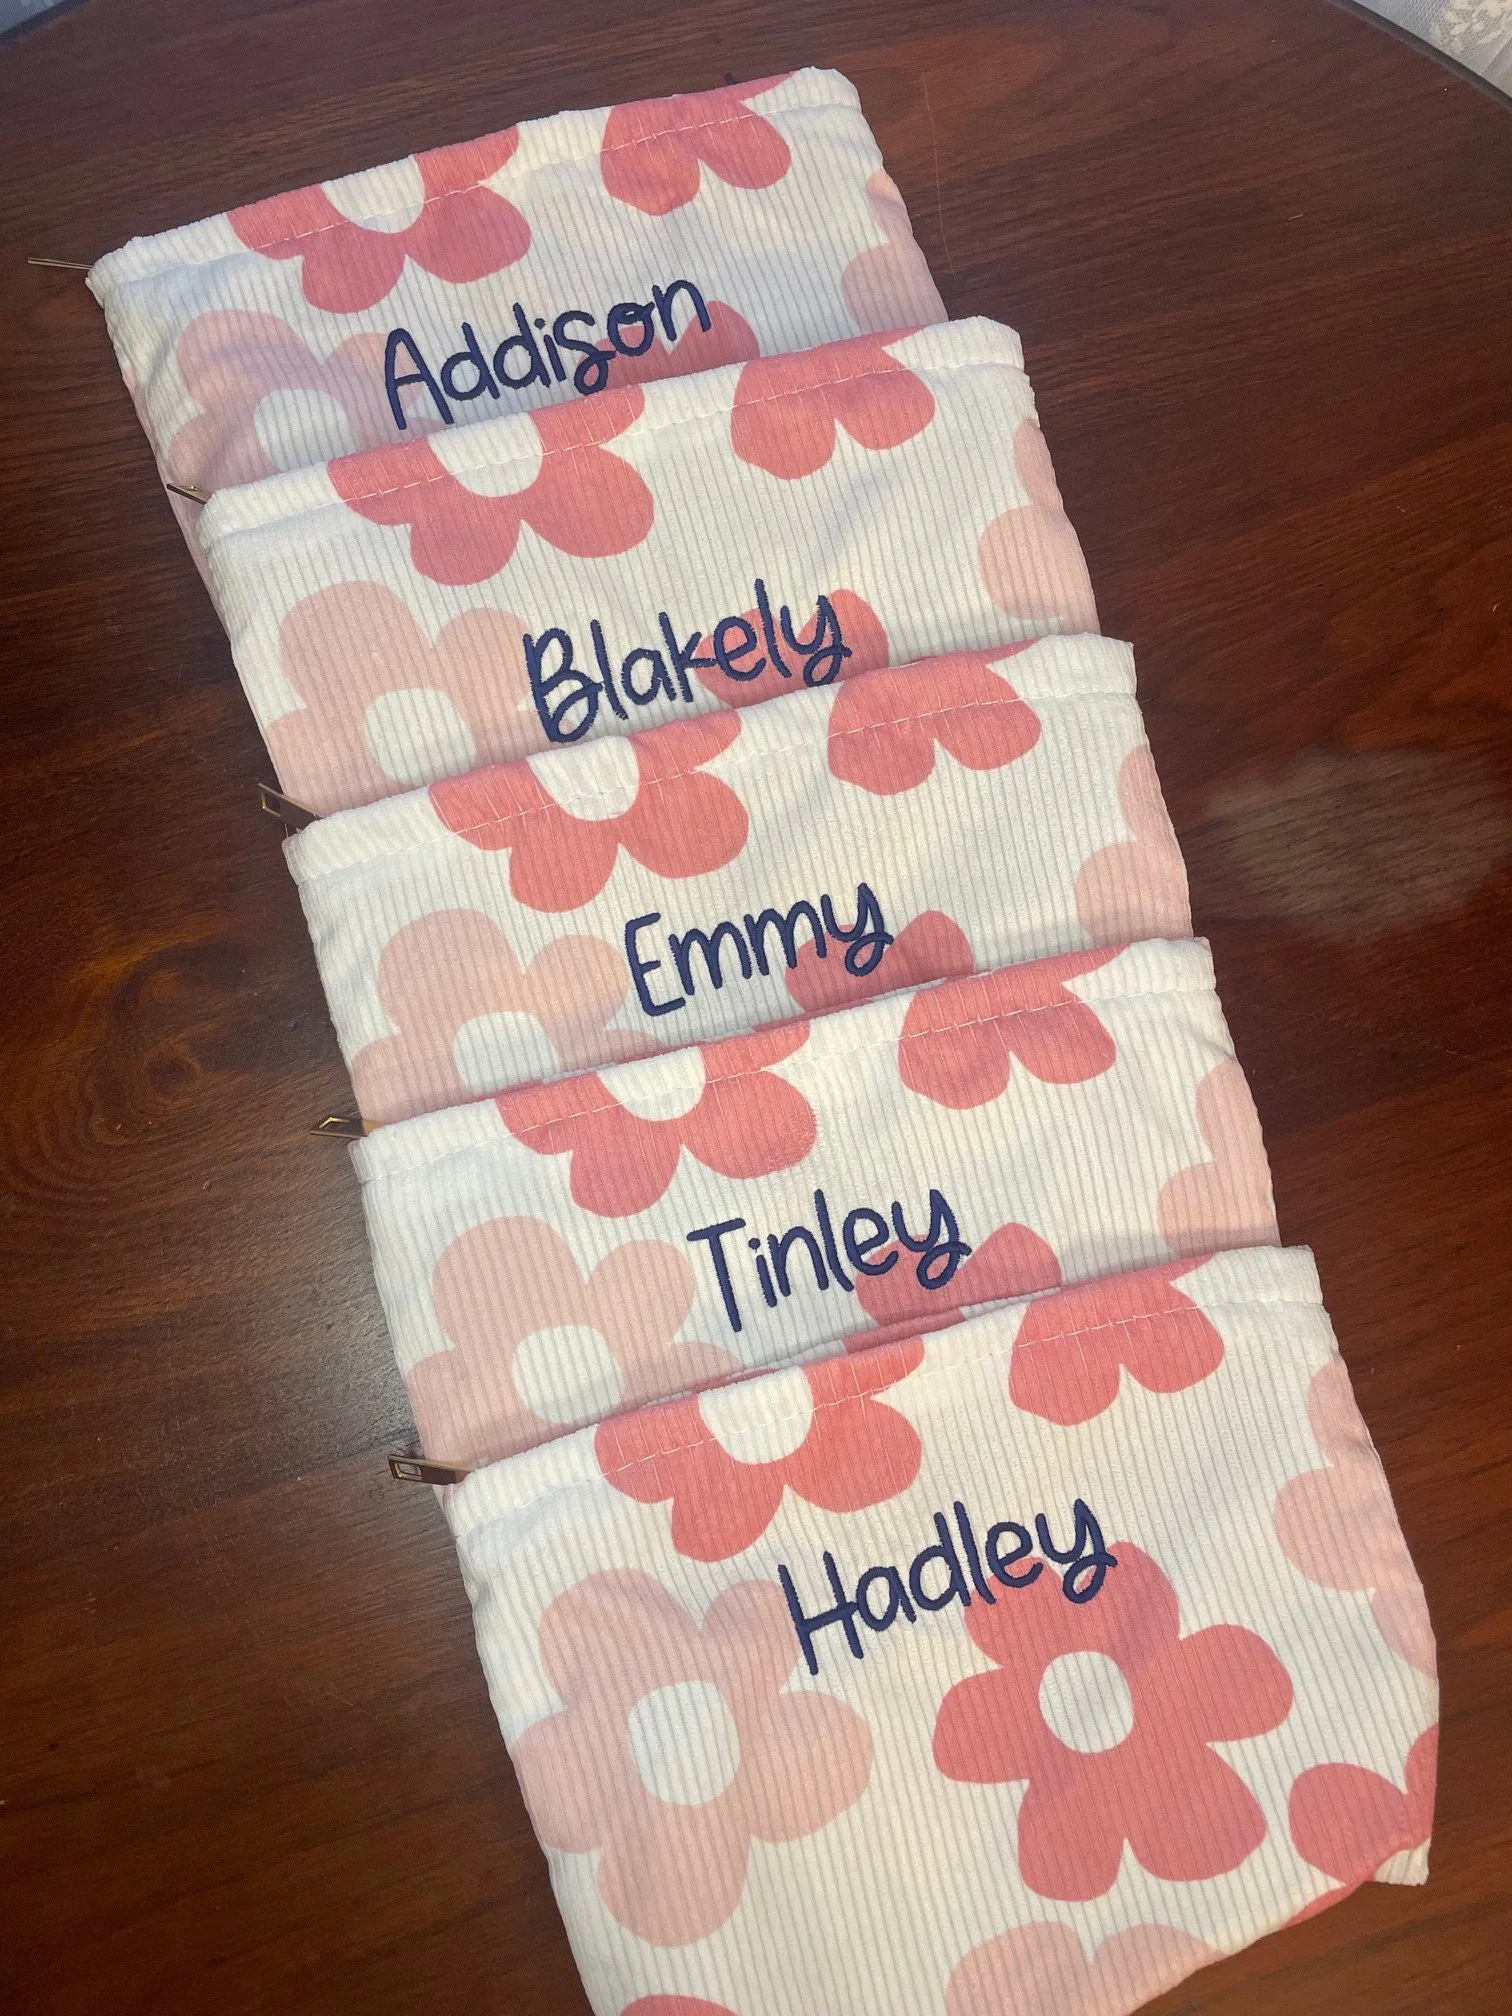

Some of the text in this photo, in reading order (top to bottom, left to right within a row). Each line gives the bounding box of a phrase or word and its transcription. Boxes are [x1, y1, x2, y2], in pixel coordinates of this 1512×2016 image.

[385, 280, 711, 430] Addison
[523, 579, 851, 743] Blakely
[625, 883, 893, 1016] Emmy
[687, 1189, 972, 1332] Tinley
[778, 1499, 1117, 1675] Hadley
